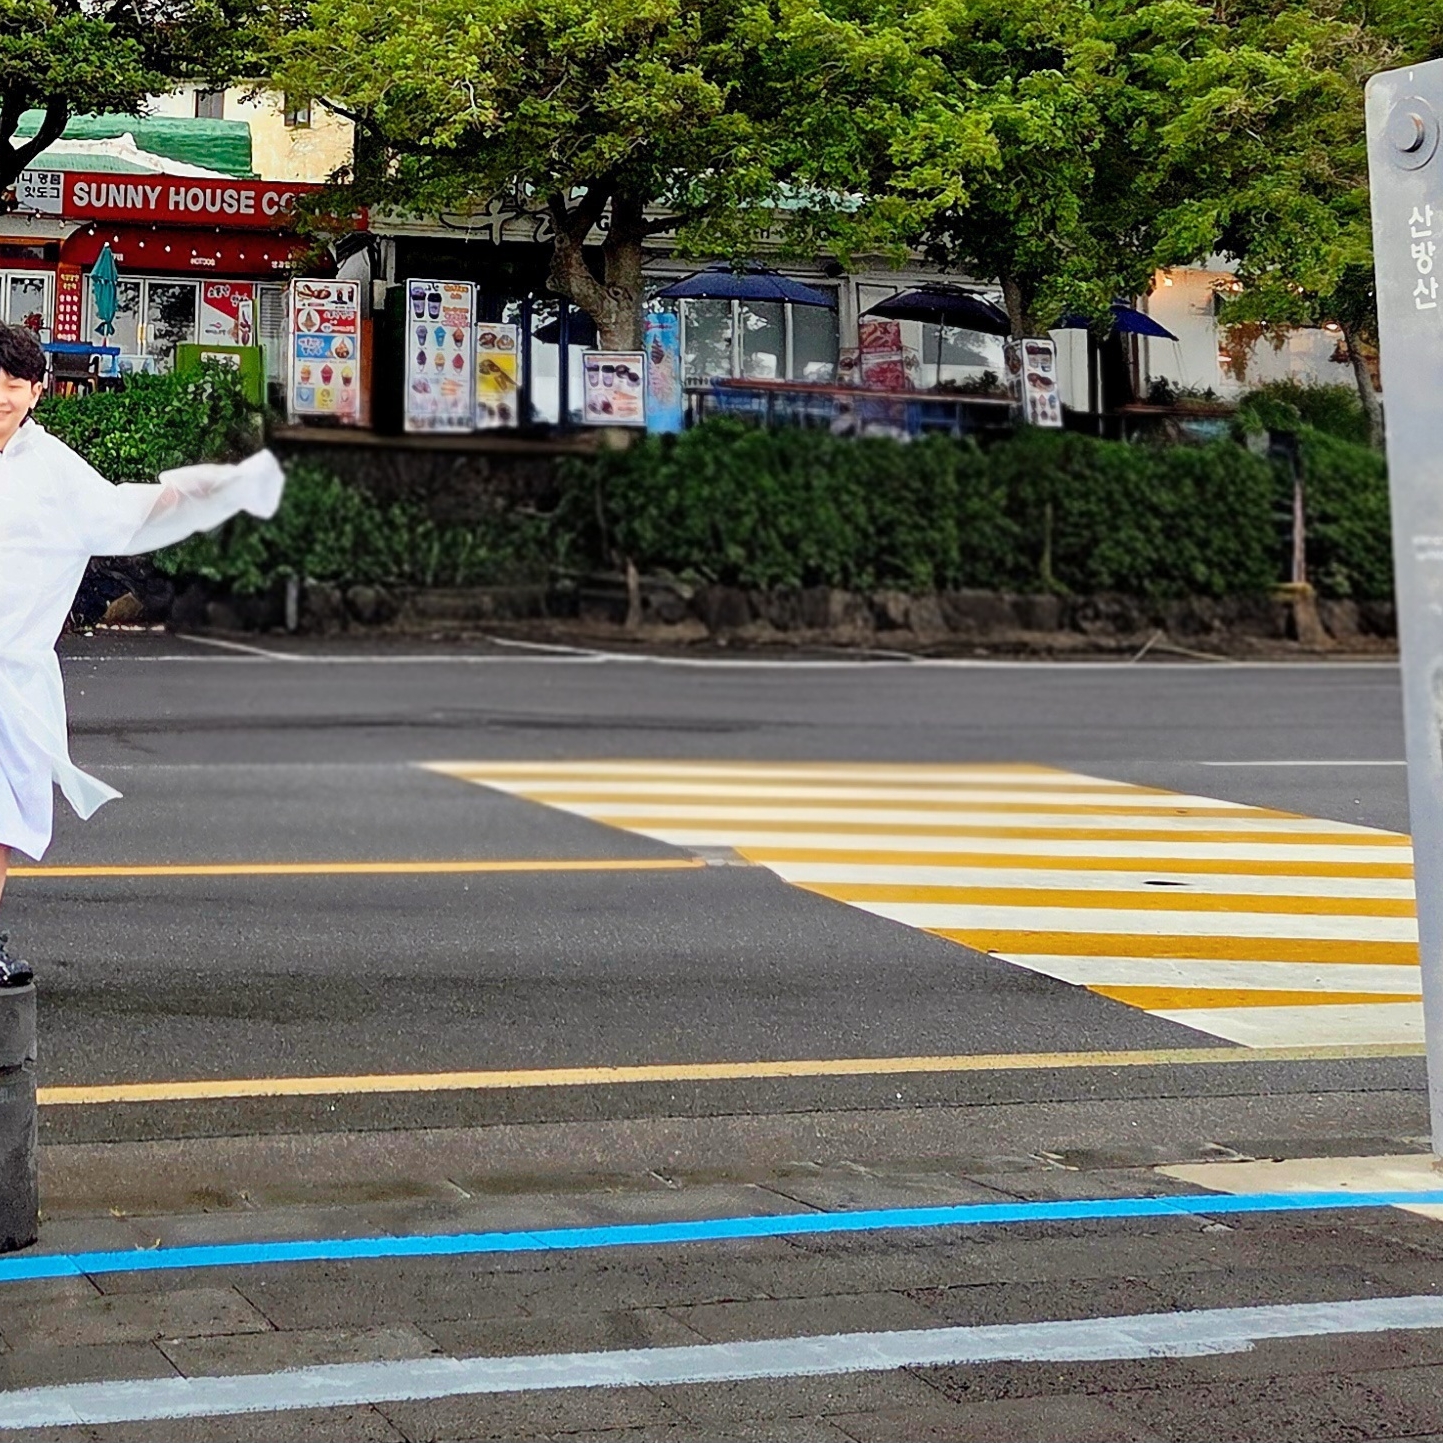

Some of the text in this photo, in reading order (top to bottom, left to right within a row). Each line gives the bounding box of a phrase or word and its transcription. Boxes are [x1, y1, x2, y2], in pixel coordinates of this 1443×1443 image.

[73, 182, 162, 209] SUNNY
[168, 187, 256, 214] HOUSE
[1408, 204, 1439, 310] 산방산
